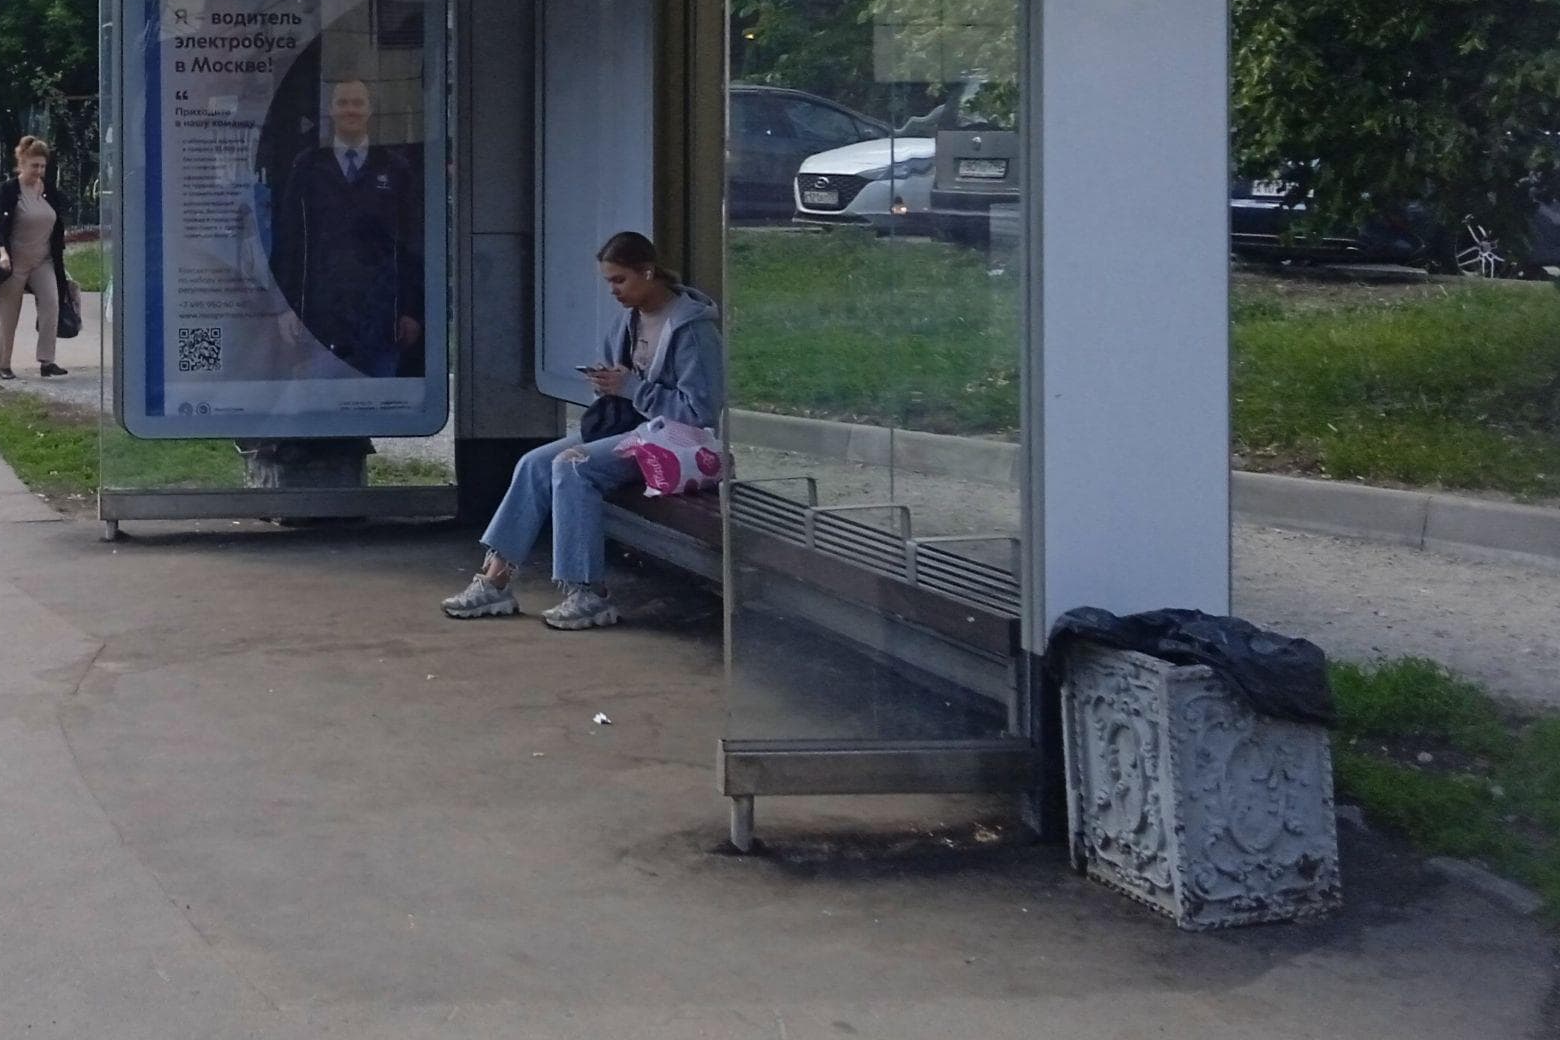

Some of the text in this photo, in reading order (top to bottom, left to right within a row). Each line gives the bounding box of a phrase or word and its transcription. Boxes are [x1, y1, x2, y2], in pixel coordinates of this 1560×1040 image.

[174, 9, 188, 25] Я
[211, 12, 302, 27] водитель
[174, 33, 296, 52] электробуса
[175, 57, 273, 73] в Москве!
